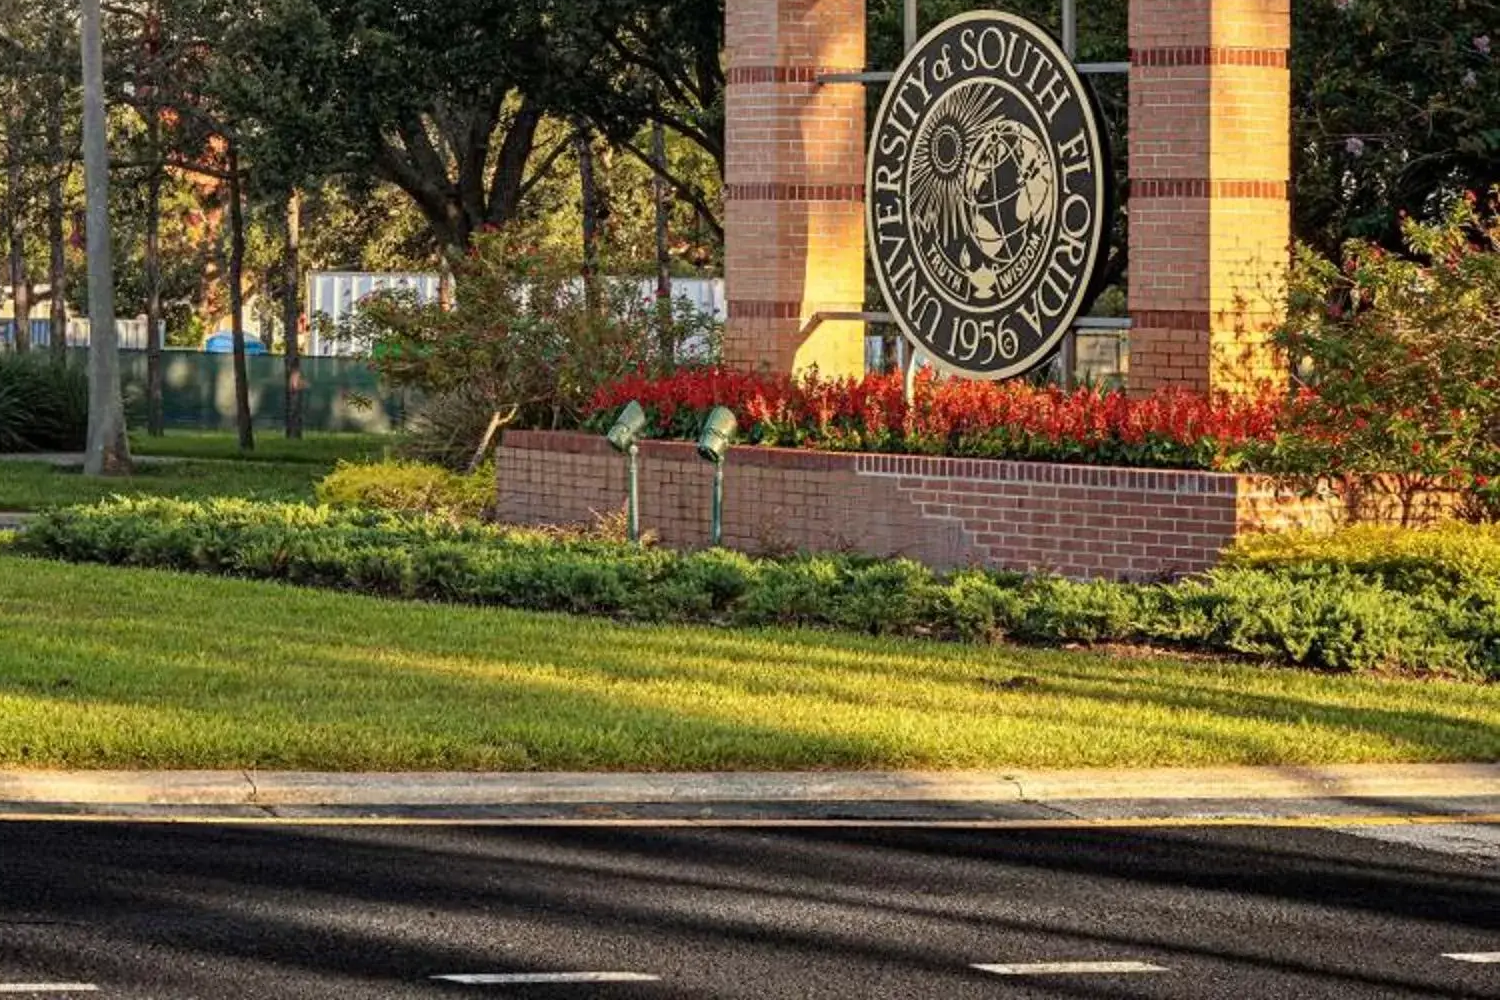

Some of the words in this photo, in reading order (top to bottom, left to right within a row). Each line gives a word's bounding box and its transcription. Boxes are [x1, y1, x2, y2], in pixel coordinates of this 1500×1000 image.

[876, 57, 943, 344] UNIVERSITY
[933, 43, 954, 80] of
[960, 26, 1071, 122] SOUTH
[1016, 131, 1091, 339] FLORIDA
[927, 243, 963, 291] TRUTH
[999, 233, 1041, 290] WISDOM
[949, 315, 1019, 365] 1956
